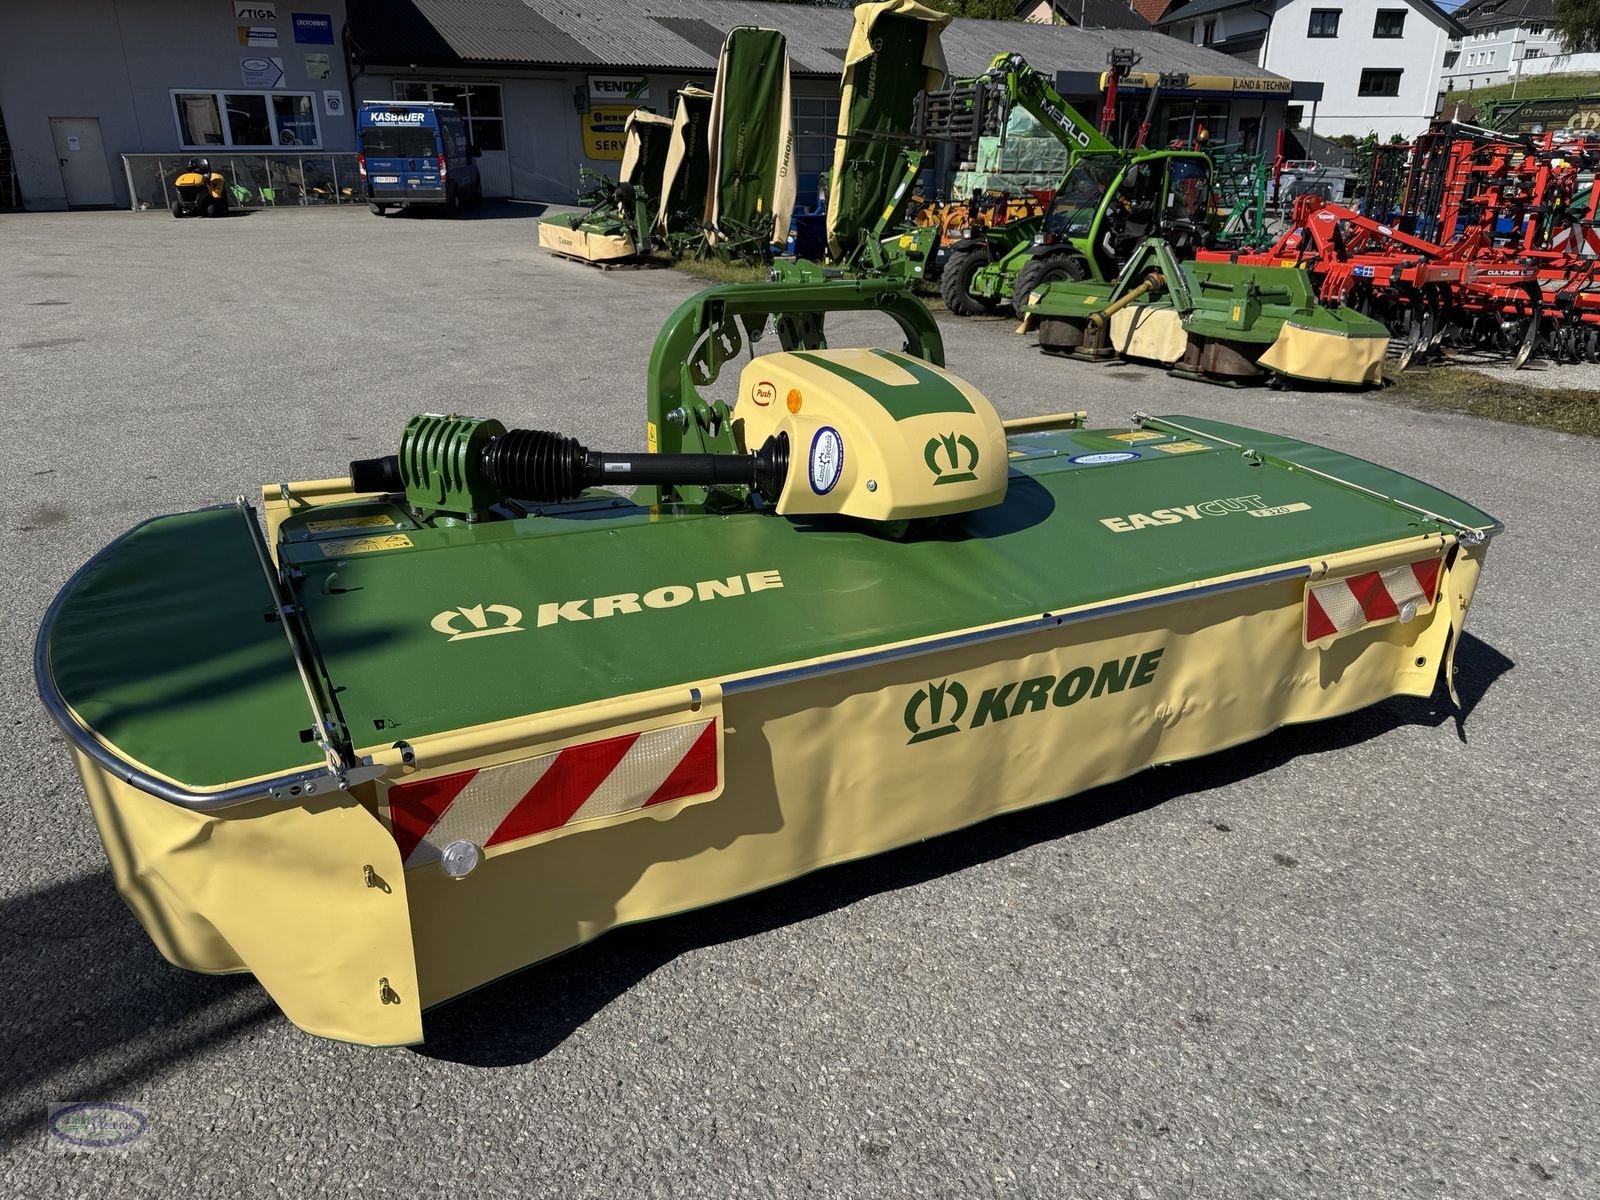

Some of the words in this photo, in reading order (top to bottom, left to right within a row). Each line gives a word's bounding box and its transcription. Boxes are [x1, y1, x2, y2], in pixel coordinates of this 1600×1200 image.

[238, 9, 276, 19] STIGA
[1235, 79, 1255, 89] LAND
[1255, 79, 1260, 89] &
[1263, 80, 1291, 91] TECHNIK
[370, 112, 425, 122] KASBAUER
[1040, 97, 1090, 148] MERLO
[595, 139, 625, 151] SERV
[783, 130, 793, 167] KRONE
[756, 389, 771, 399] Push
[816, 464, 826, 483] Land
[824, 434, 833, 460] Technik
[1100, 494, 1268, 533] EASYCUT
[537, 569, 784, 628] KRONE
[969, 647, 1166, 729] KRONE
